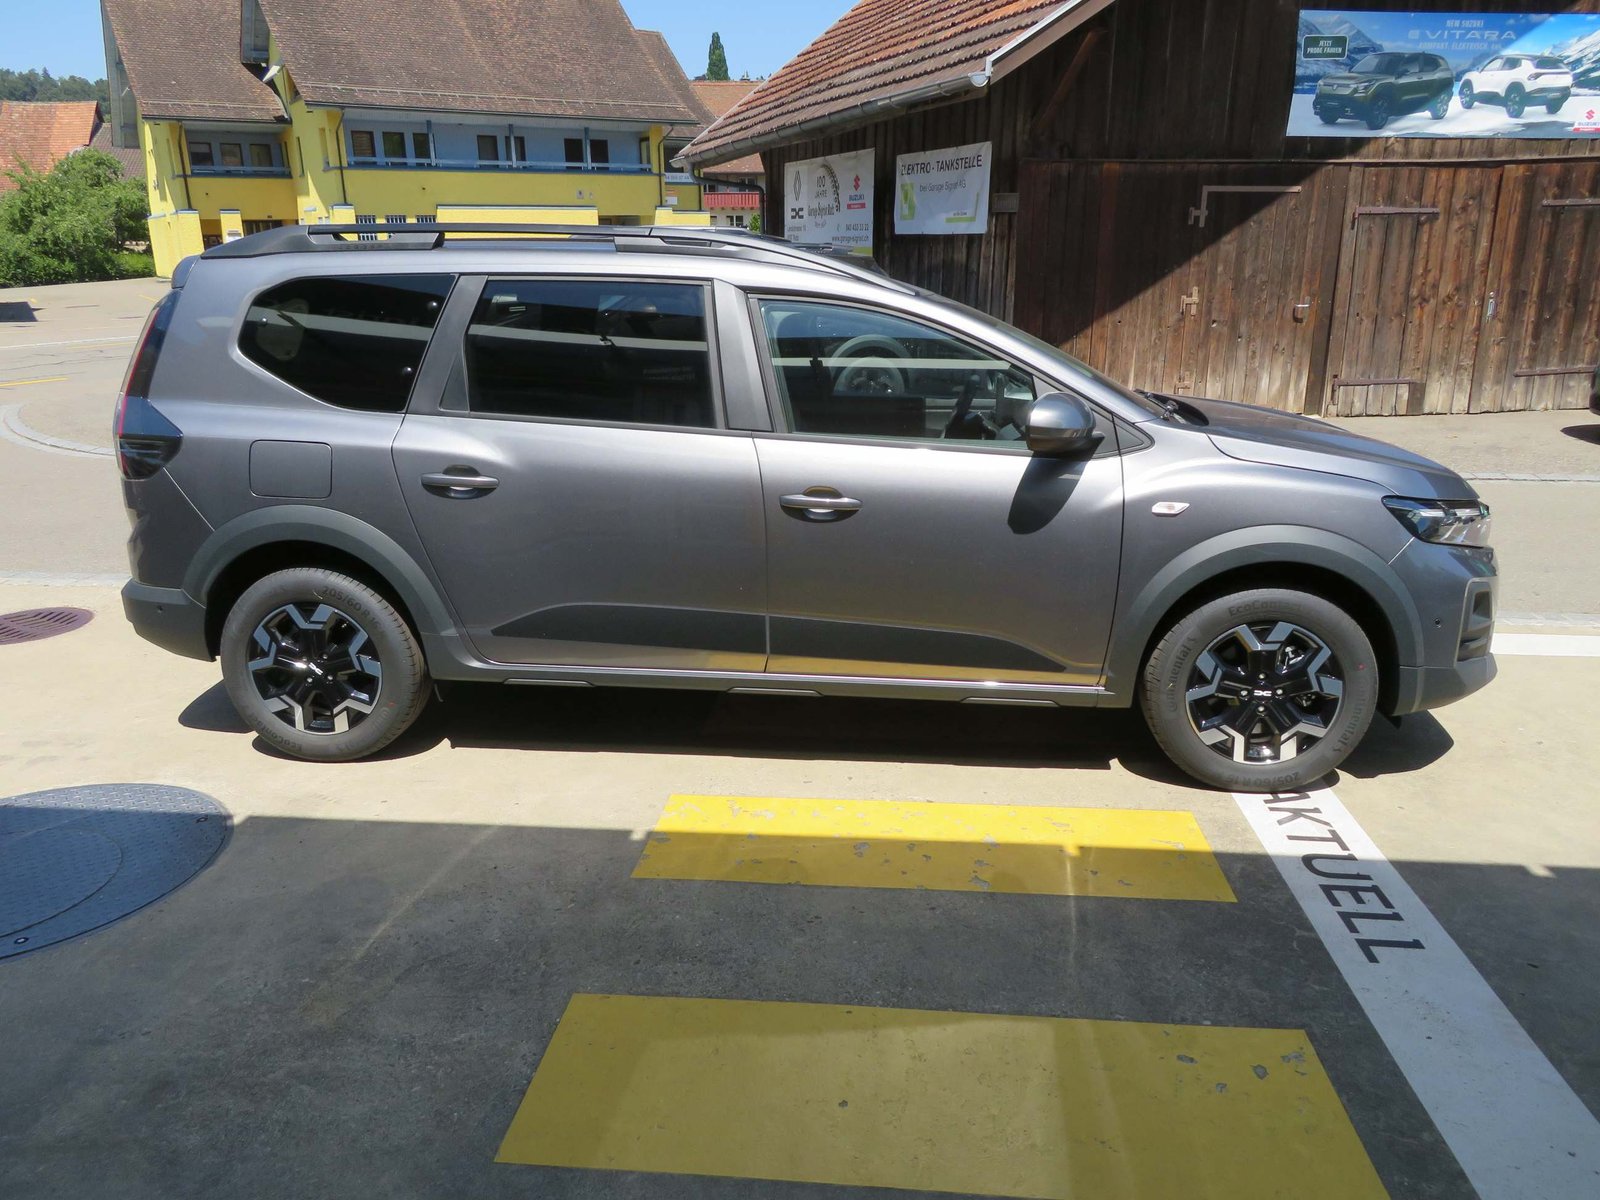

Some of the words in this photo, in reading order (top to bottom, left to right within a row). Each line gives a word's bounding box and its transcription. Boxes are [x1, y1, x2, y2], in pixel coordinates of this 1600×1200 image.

[936, 154, 983, 173] TANKSTELLE
[816, 175, 826, 188] 100
[848, 194, 865, 202] SUZUKI
[1263, 792, 1426, 964] AKTUELL
